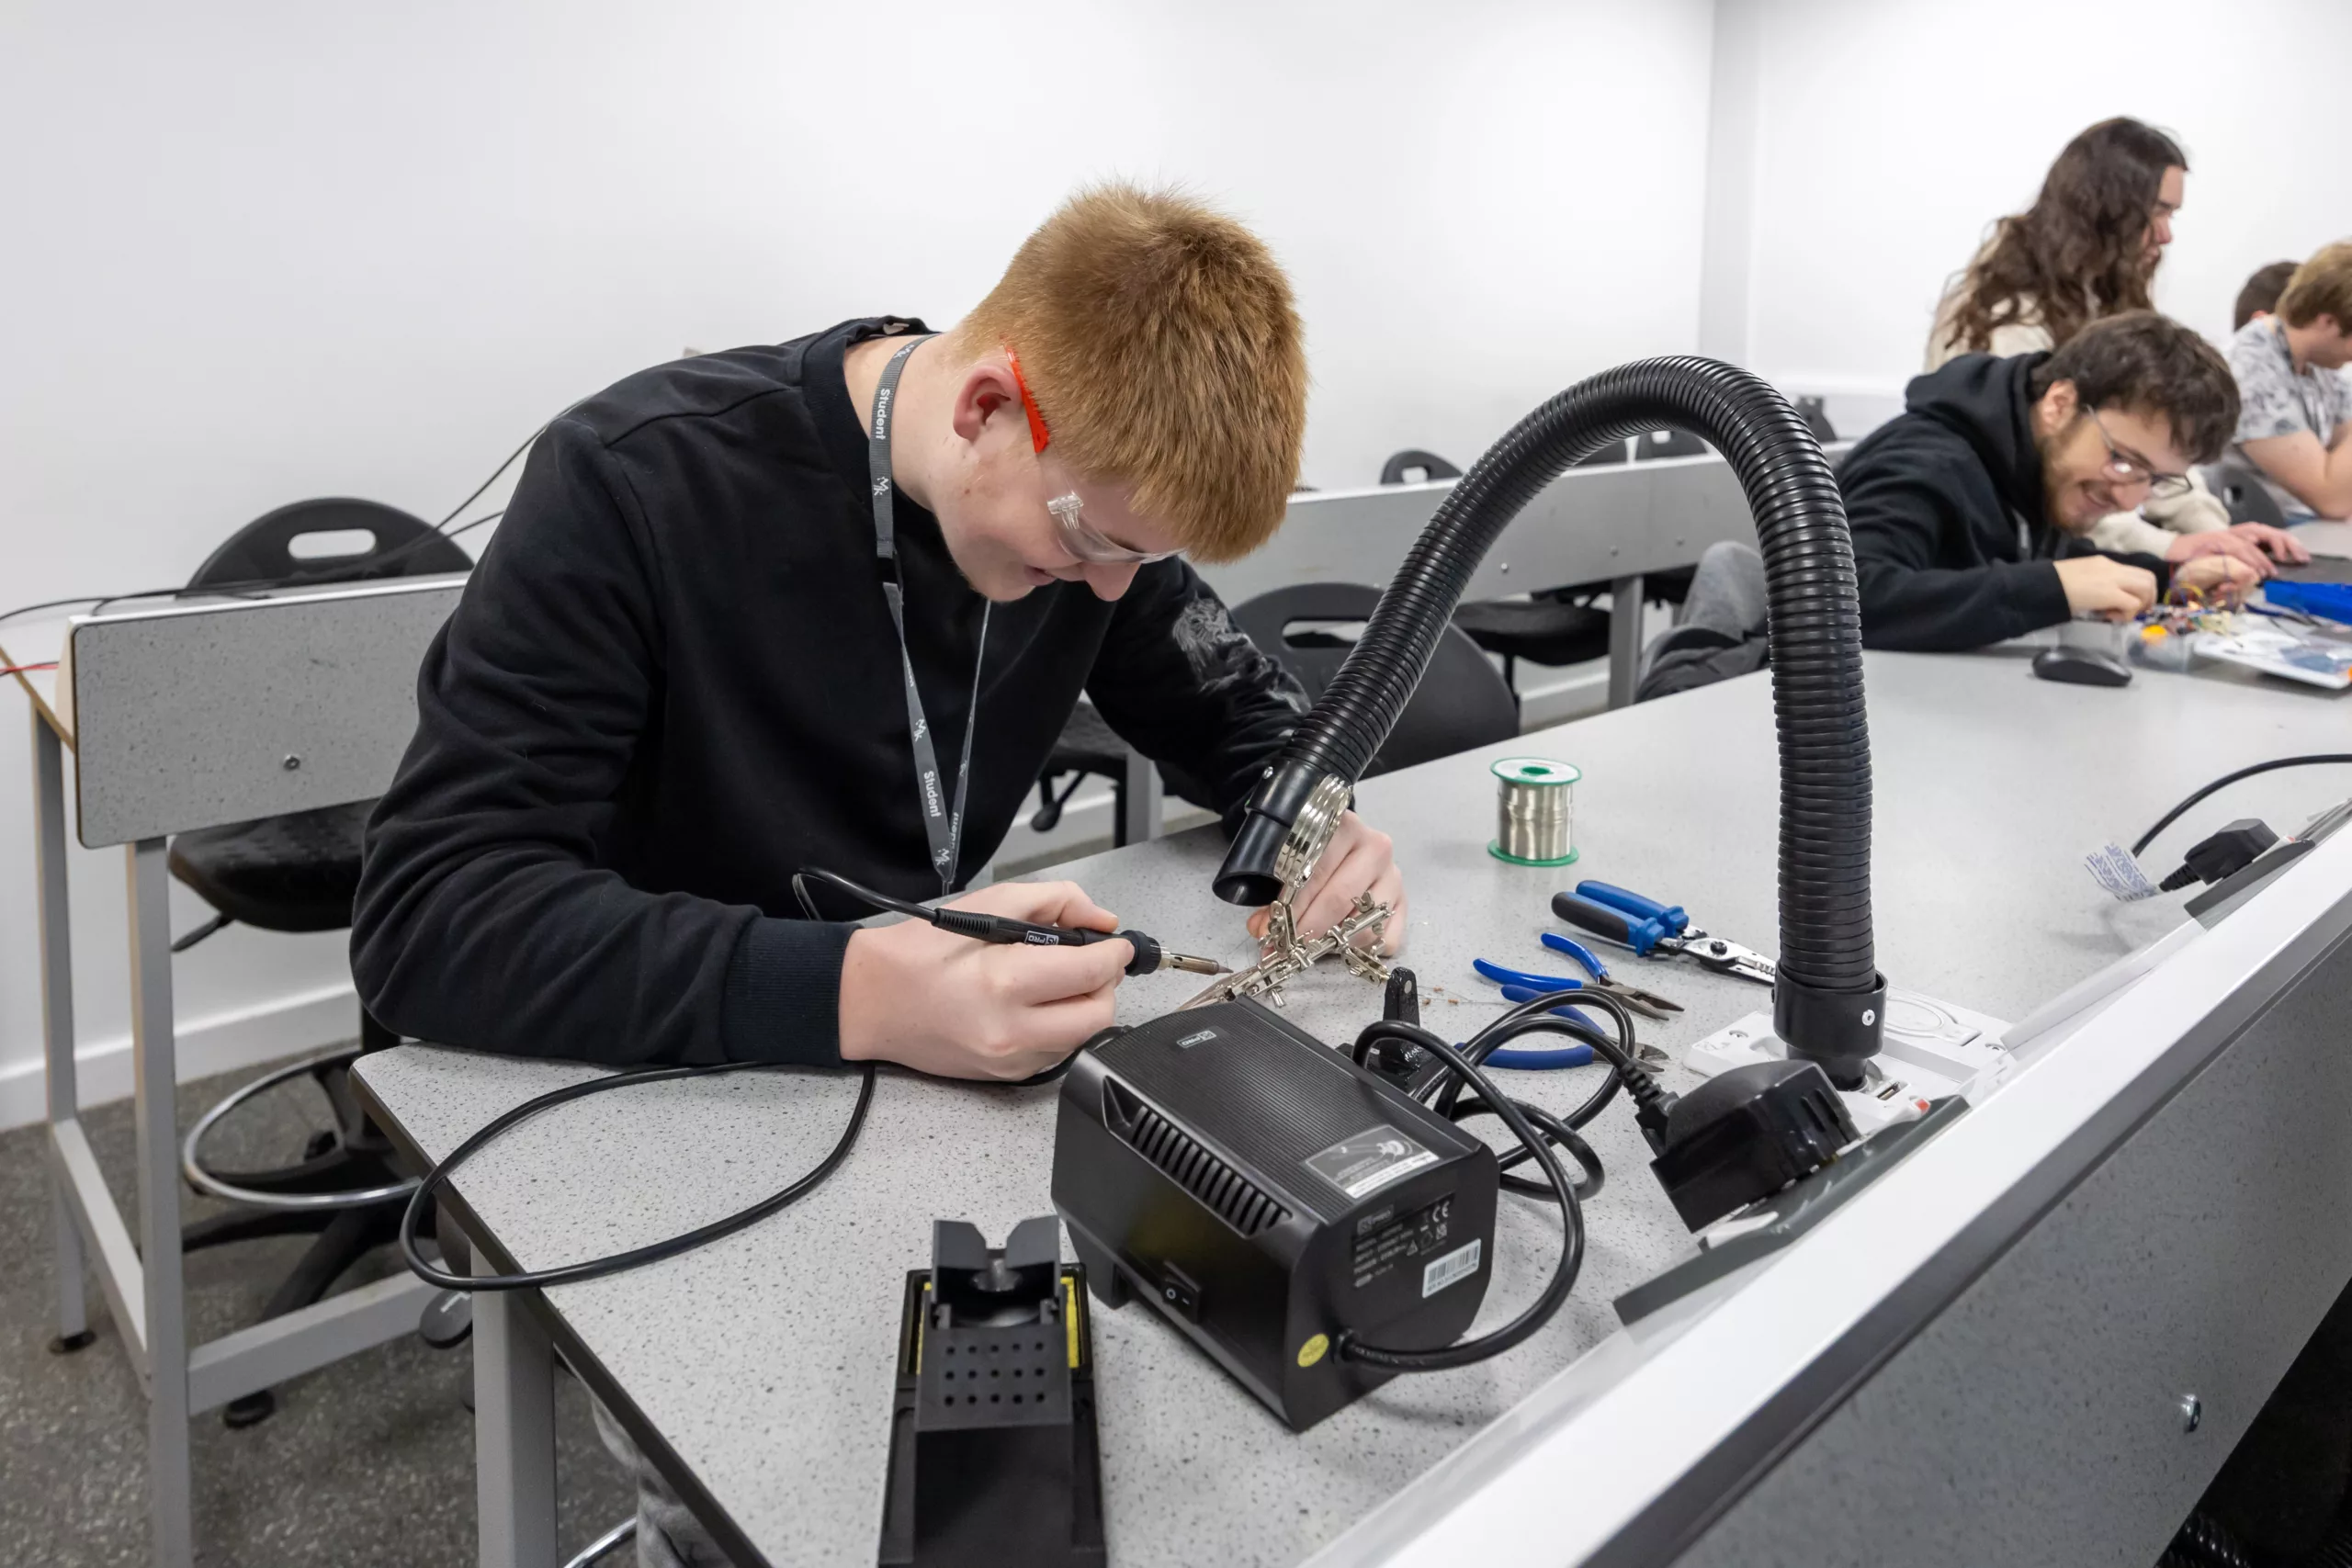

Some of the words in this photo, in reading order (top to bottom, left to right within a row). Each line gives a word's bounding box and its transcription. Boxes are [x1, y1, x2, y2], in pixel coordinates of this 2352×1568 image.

[876, 388, 890, 440] Student
[923, 770, 942, 818] Student
[1027, 934, 1046, 944] PRO
